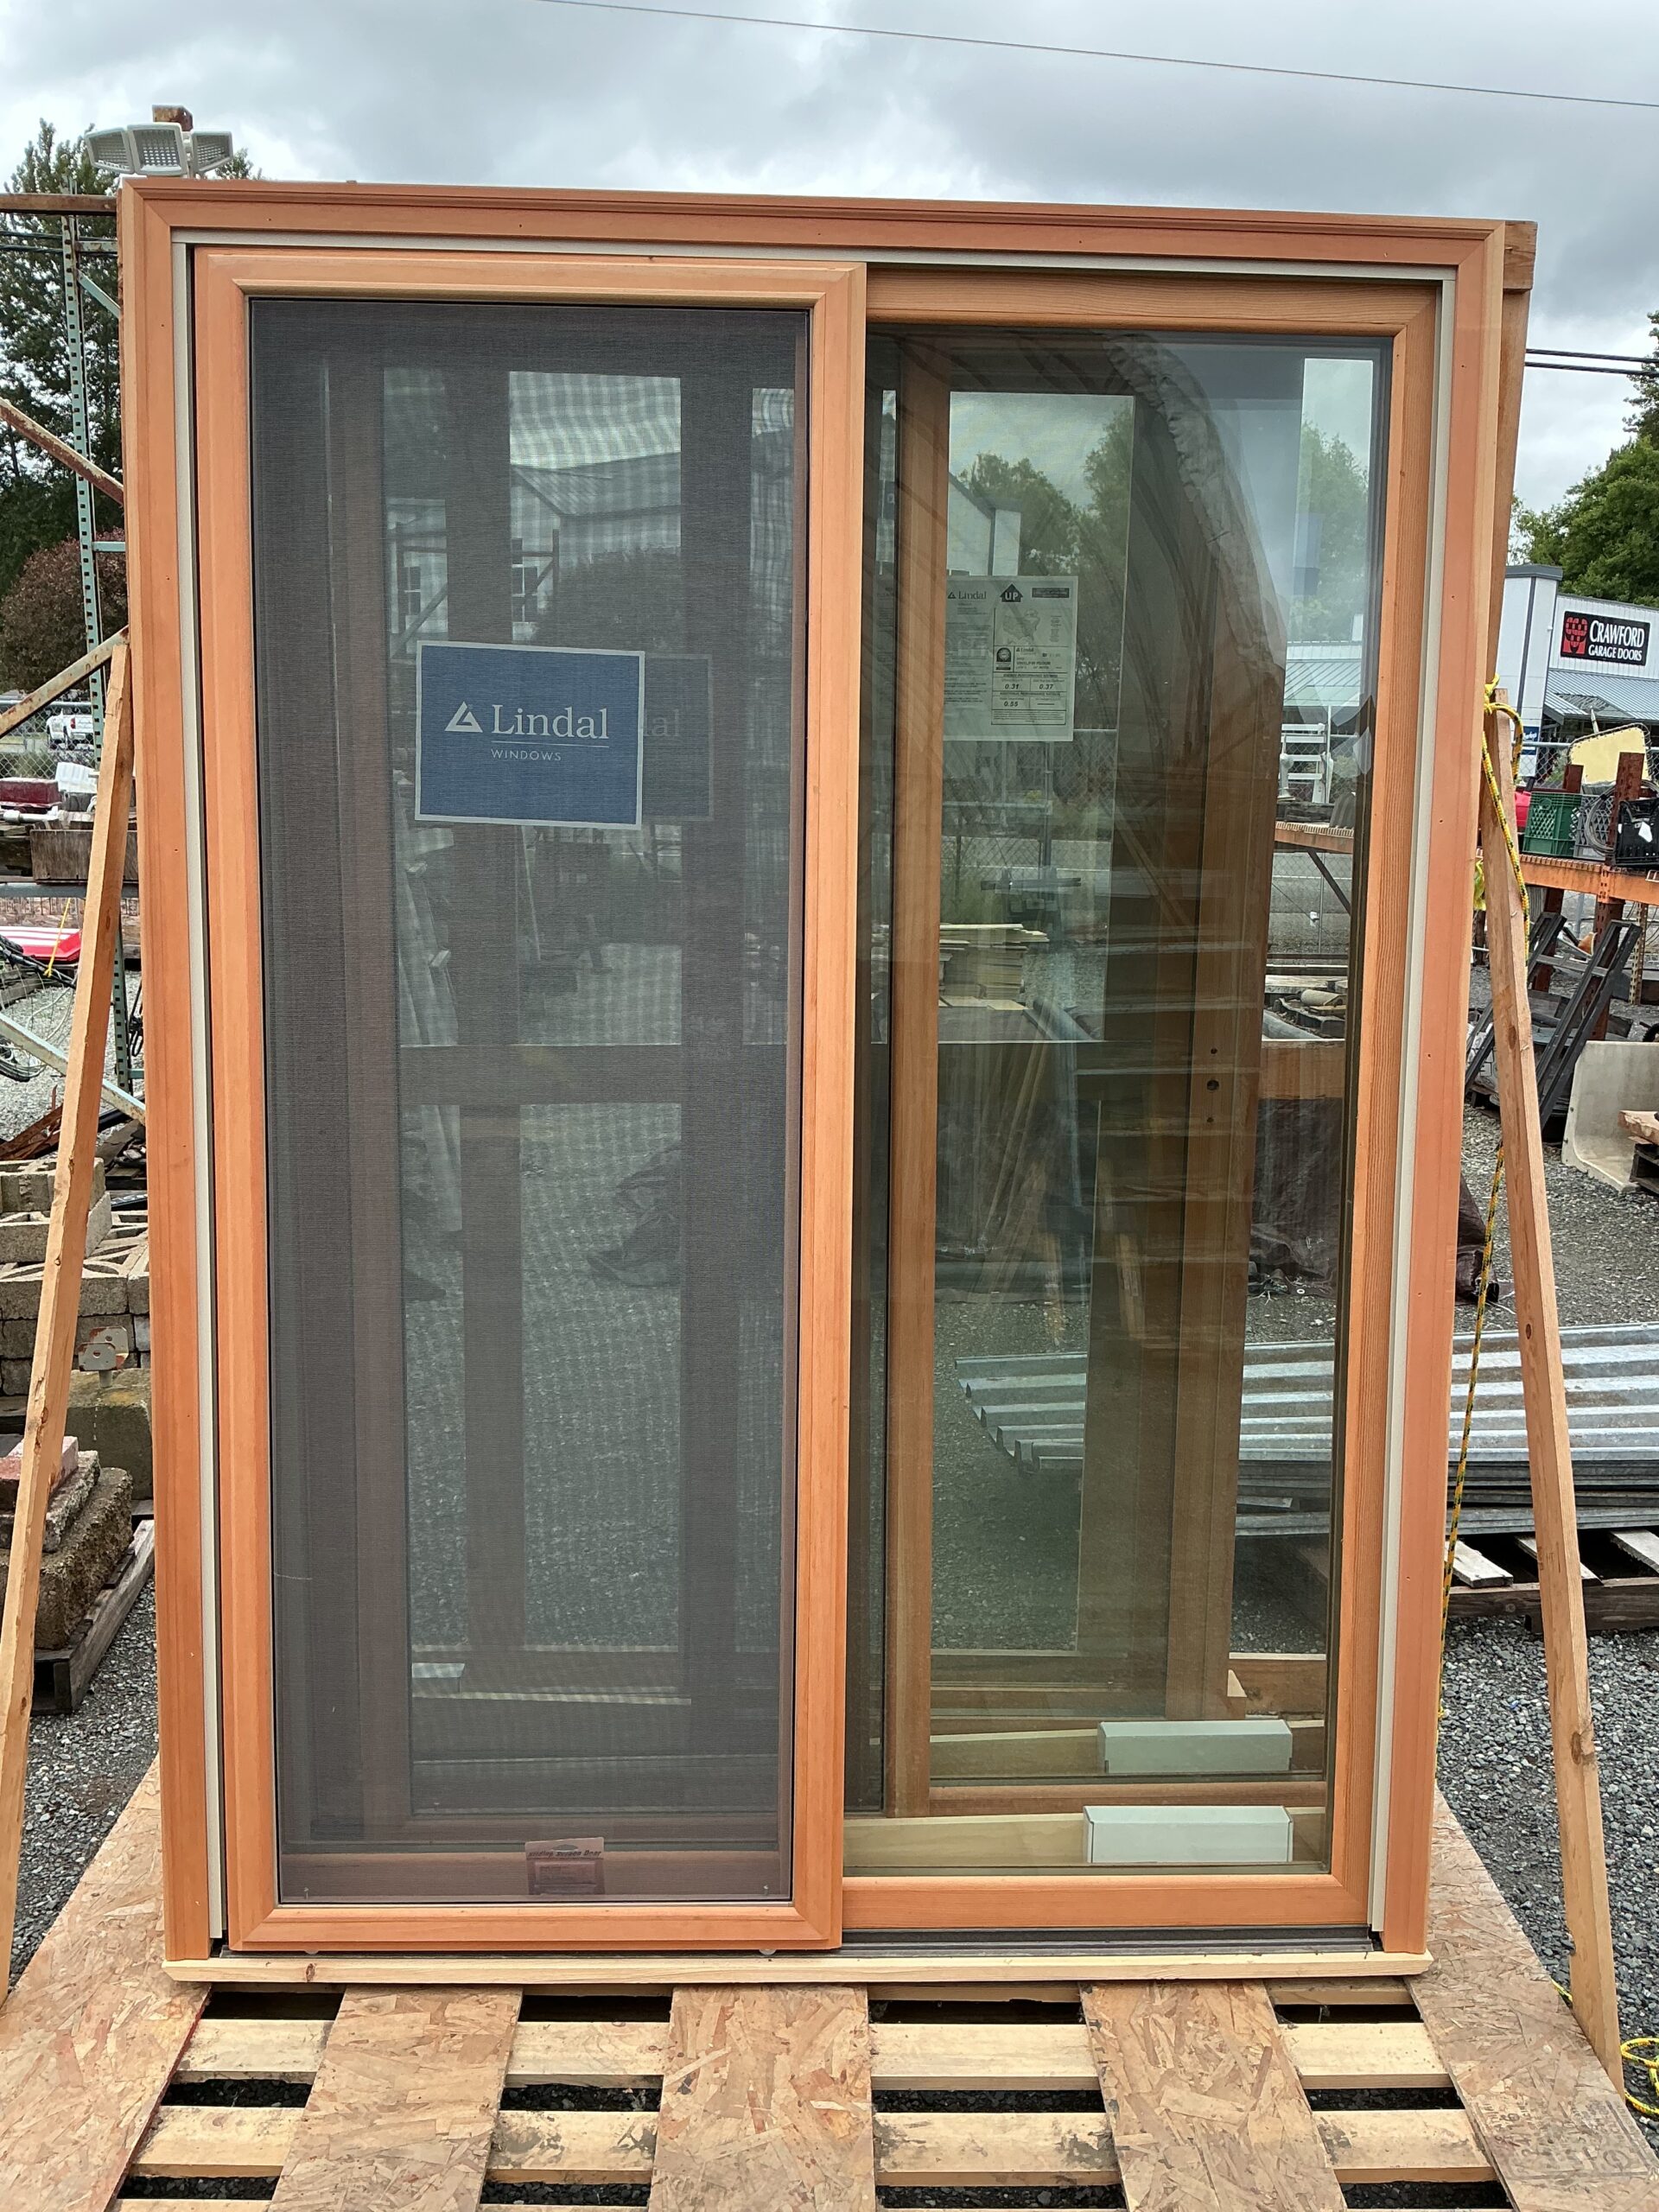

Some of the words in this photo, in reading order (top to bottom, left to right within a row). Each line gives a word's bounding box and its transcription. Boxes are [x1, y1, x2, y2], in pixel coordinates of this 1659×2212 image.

[958, 591, 987, 600] Lindal
[1004, 592, 1019, 601] UP
[1590, 620, 1645, 648] CRAWFORD
[1588, 645, 1617, 658] GARAGE
[1617, 648, 1643, 661] DOORS
[491, 704, 609, 739] Lindal
[491, 748, 562, 760] WINDOWS
